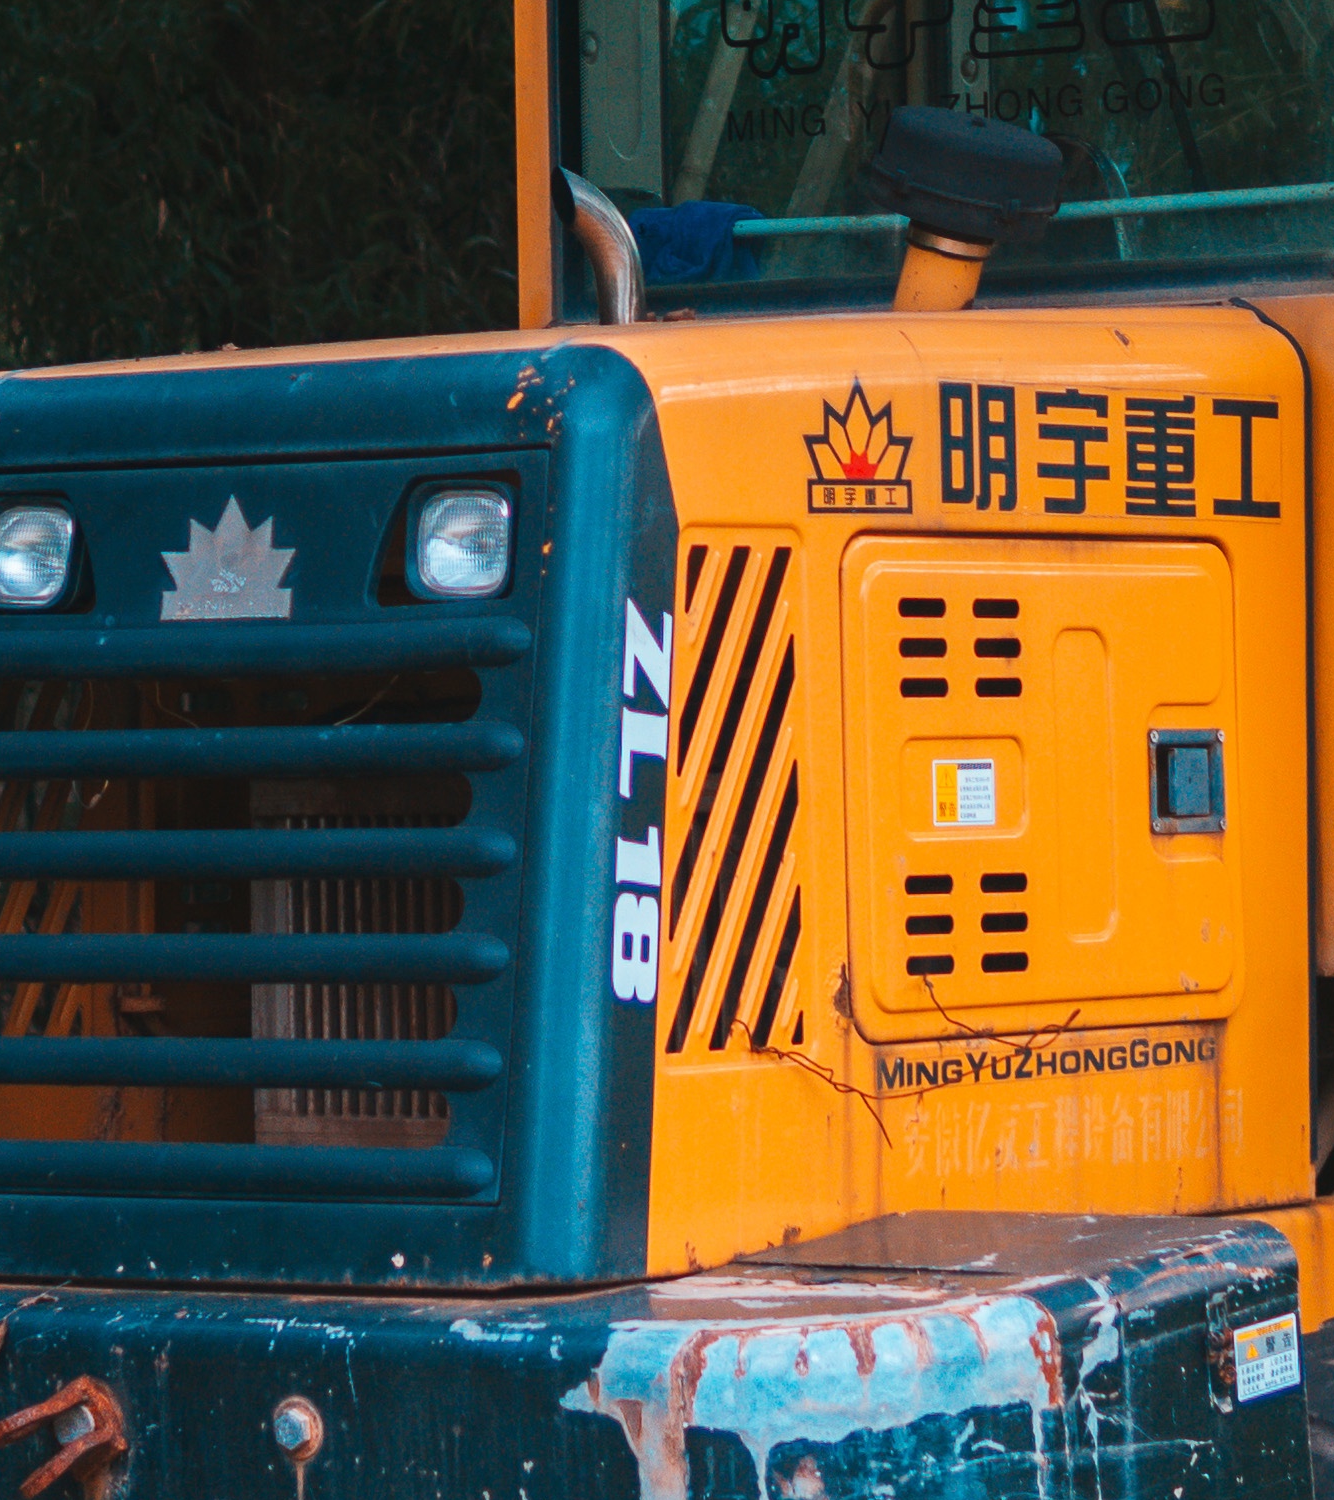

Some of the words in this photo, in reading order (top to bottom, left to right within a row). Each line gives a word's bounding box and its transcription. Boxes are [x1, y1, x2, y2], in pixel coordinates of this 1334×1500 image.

[727, 104, 827, 143] MING
[1102, 72, 1227, 115] GONG
[939, 380, 1282, 519] 明宇重工
